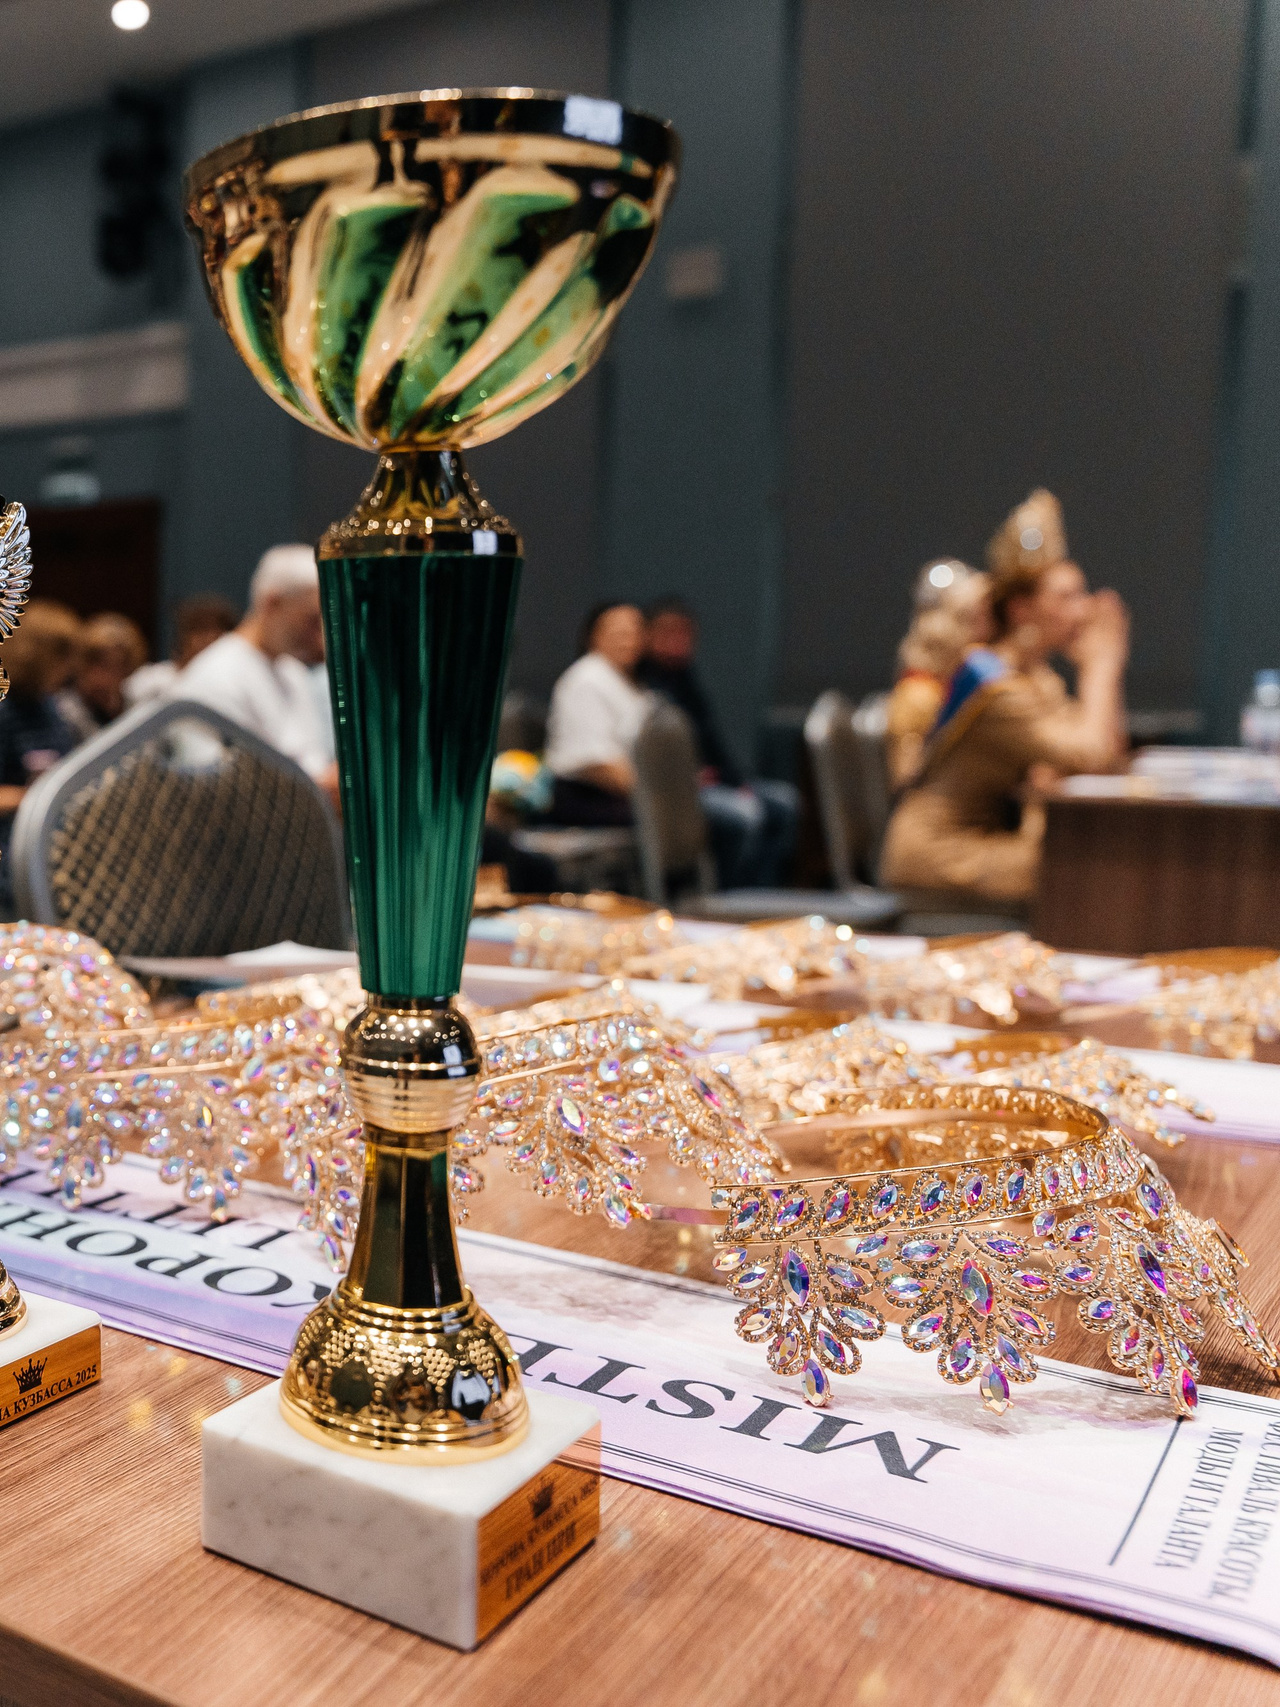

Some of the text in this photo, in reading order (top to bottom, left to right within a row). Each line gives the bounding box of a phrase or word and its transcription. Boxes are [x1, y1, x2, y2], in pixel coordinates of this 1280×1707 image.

[13, 1376, 73, 1415] КУЗБАССА
[75, 1364, 97, 1386] 2025
[517, 1333, 960, 1484] MIST
[1154, 1426, 1243, 1569] МОДЫ И ТАЛАНТА
